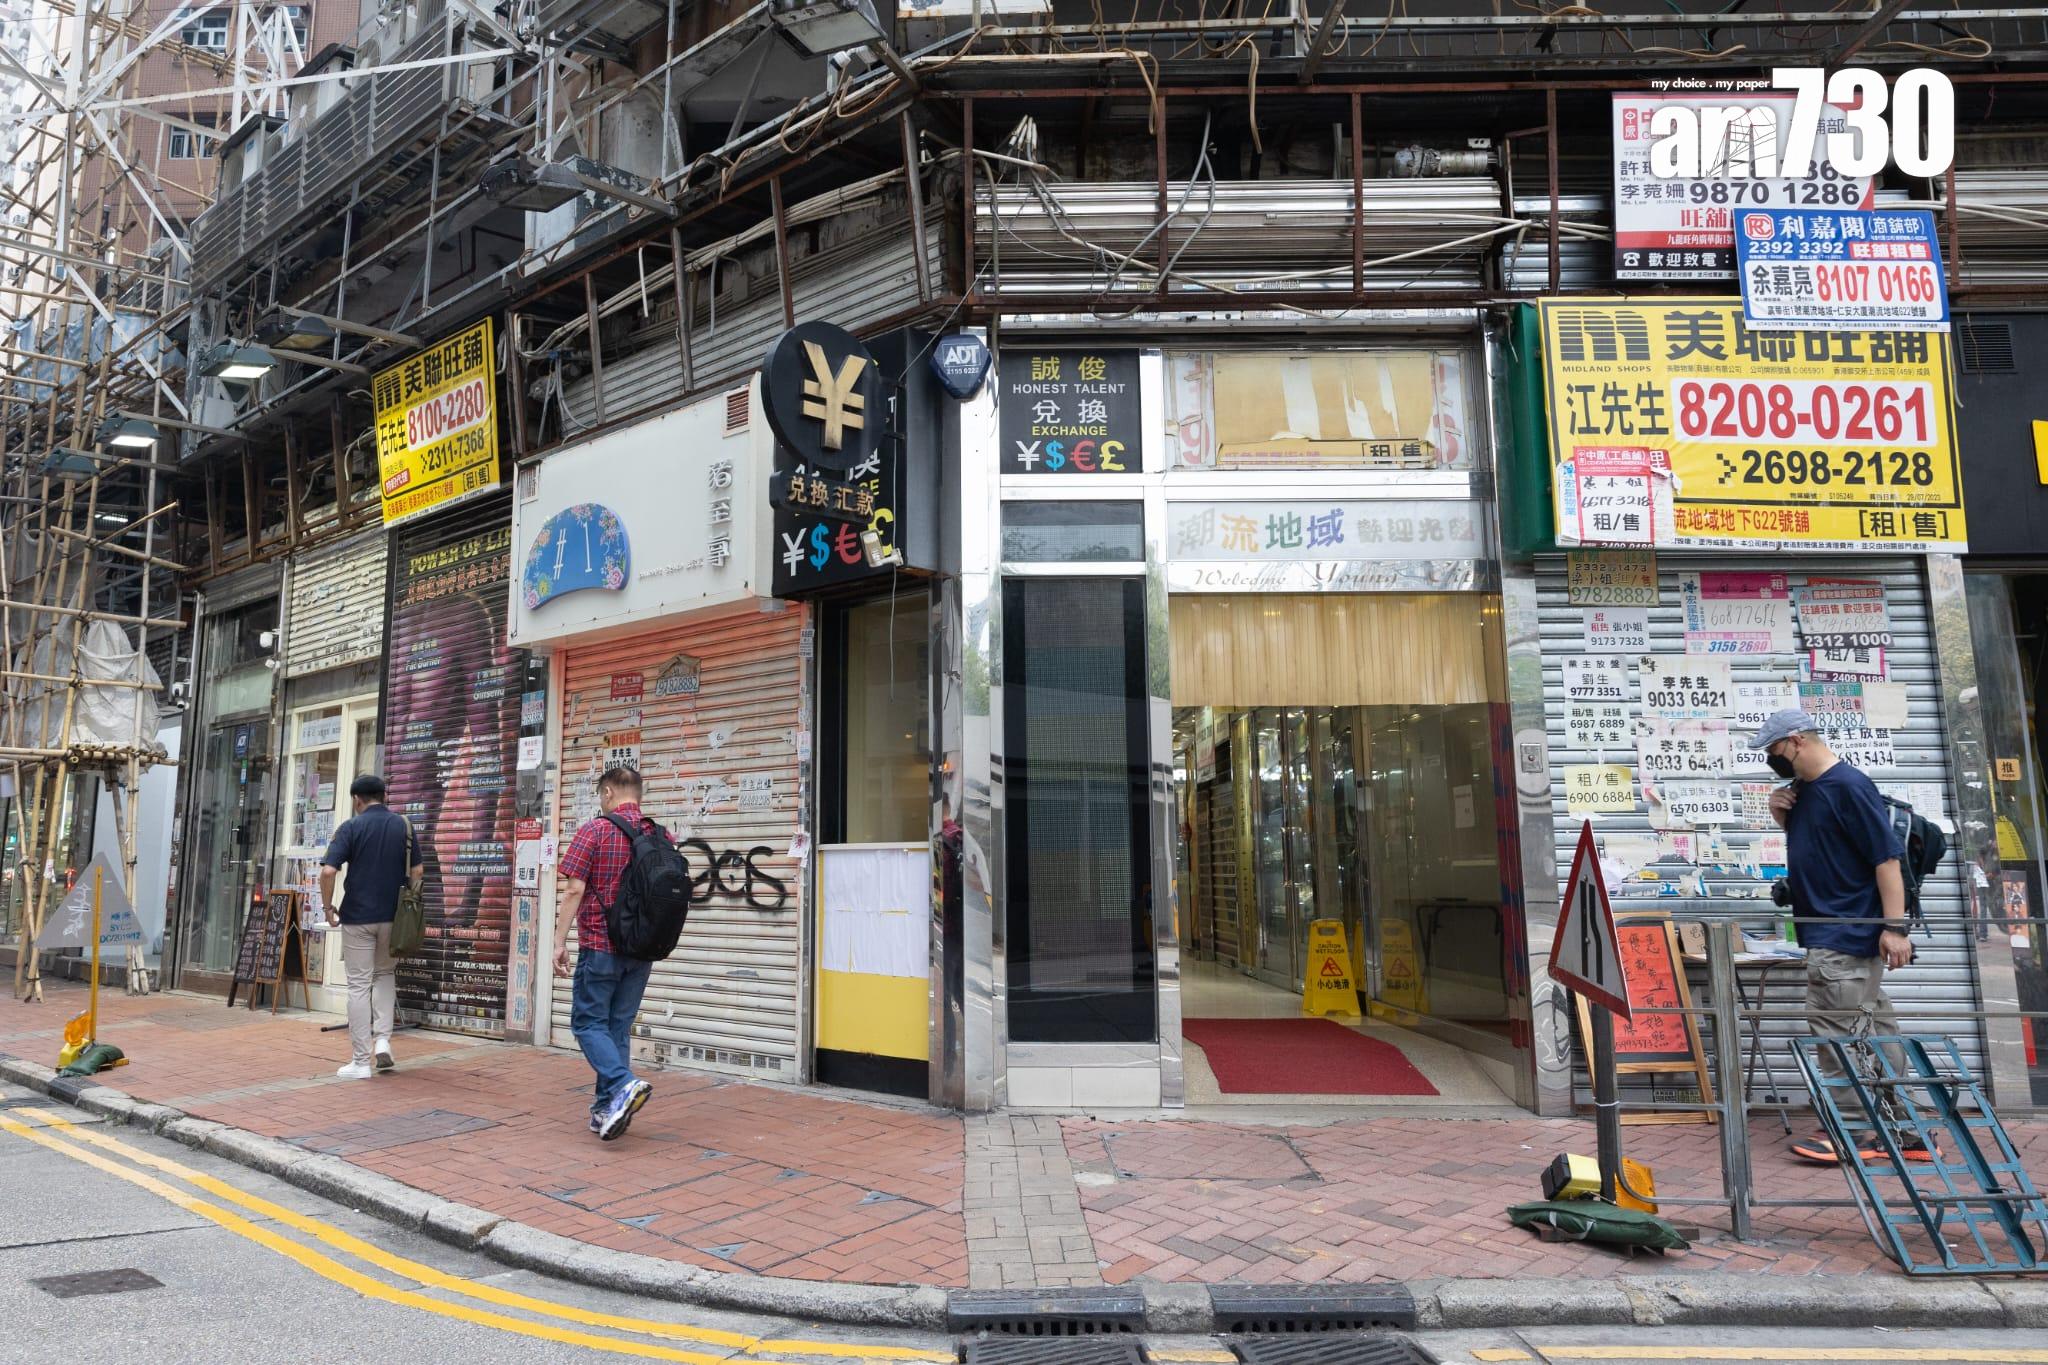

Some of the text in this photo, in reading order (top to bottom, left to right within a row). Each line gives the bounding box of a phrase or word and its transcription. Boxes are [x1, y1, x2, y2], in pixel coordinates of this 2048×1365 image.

[1690, 182, 1770, 205] 9870
[1782, 182, 1860, 206] 1286
[1680, 207, 1735, 228] 旺舖
[1748, 241, 1844, 255] 2392 3392
[1815, 264, 1871, 303] 8107
[1877, 265, 1935, 303] 0166
[944, 344, 980, 365] ADT
[404, 332, 483, 399] 美聯旺舖
[1031, 356, 1108, 382] 誠俊
[1561, 365, 1653, 374] MIDLAND SHOPS
[1012, 383, 1126, 394] HONEST TALENT
[1566, 380, 1929, 442] 江先生 8208-0261
[379, 415, 407, 457] 石先生
[407, 380, 486, 446] 8100-2280
[1032, 426, 1108, 436] EXCHANGE
[427, 427, 485, 472] 2311-7368
[1742, 449, 1934, 487] 2698-2128
[1593, 513, 1640, 531] 租/售
[1176, 507, 1345, 556] 潮流地域
[409, 539, 481, 576] POWER OF
[1575, 563, 1648, 572] 2332 1473
[1571, 586, 1656, 604] 97828882
[1612, 622, 1643, 632] 張小姐
[1590, 636, 1645, 646] 9173 7328
[1708, 641, 1769, 653] 3156 2680
[1804, 632, 1892, 648] 2312 1000
[1662, 676, 1711, 690] 李先生
[1832, 672, 1884, 684] 2409 0188
[1570, 687, 1622, 697] 9777 3351
[1648, 690, 1727, 708] 9033 6421
[1571, 708, 1594, 718] 租/售
[1738, 712, 1766, 723] 9661
[1806, 711, 1865, 728] 7828882
[1570, 719, 1625, 729] 6987 6889
[1577, 731, 1620, 742] 林先生
[1830, 742, 1843, 750] For
[1873, 741, 1890, 749] Sale
[1736, 752, 1766, 763] 6570
[1864, 750, 1894, 766] 5434
[2001, 761, 2015, 773] 推
[1577, 772, 1620, 787] 租/售
[1569, 791, 1632, 804] 6900 6884
[1701, 802, 1729, 813] 6303
[480, 863, 509, 874] Protein
[1317, 979, 1350, 990] 小心地滑
